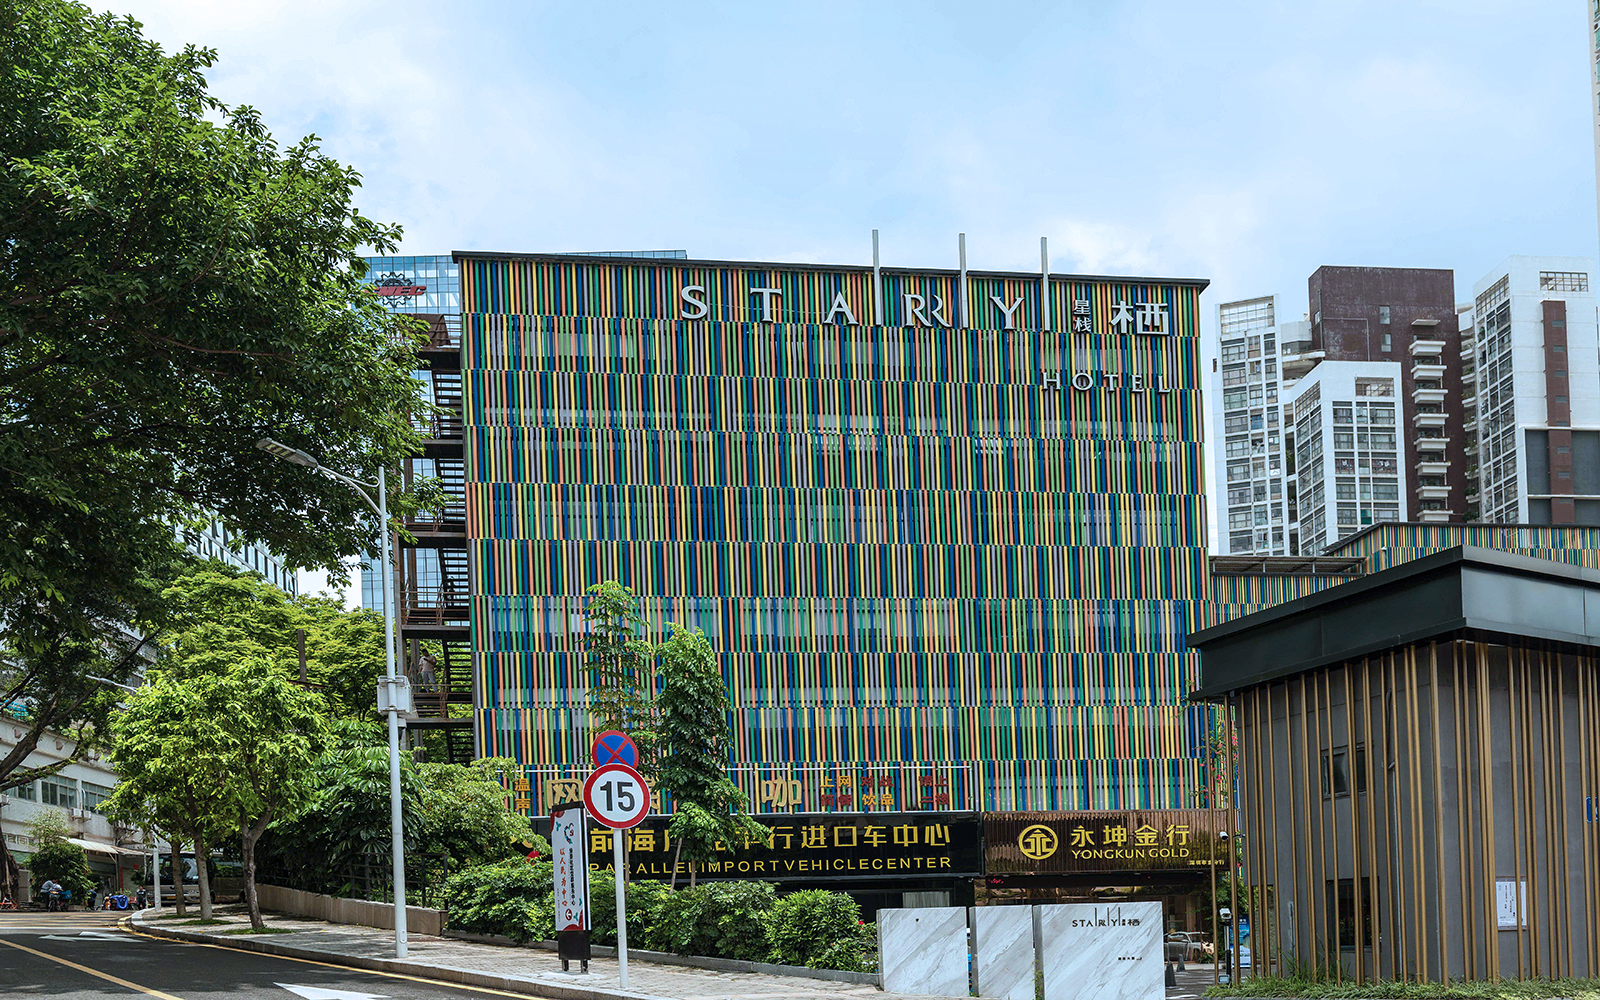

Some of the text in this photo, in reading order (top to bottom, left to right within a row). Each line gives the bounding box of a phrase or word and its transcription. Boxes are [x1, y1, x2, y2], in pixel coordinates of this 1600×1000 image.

[1042, 371, 1172, 394] HOTEL
[600, 781, 636, 812] 15
[1071, 824, 1190, 848] 永坤金行
[1071, 847, 1190, 860] YONGKUN GOLD
